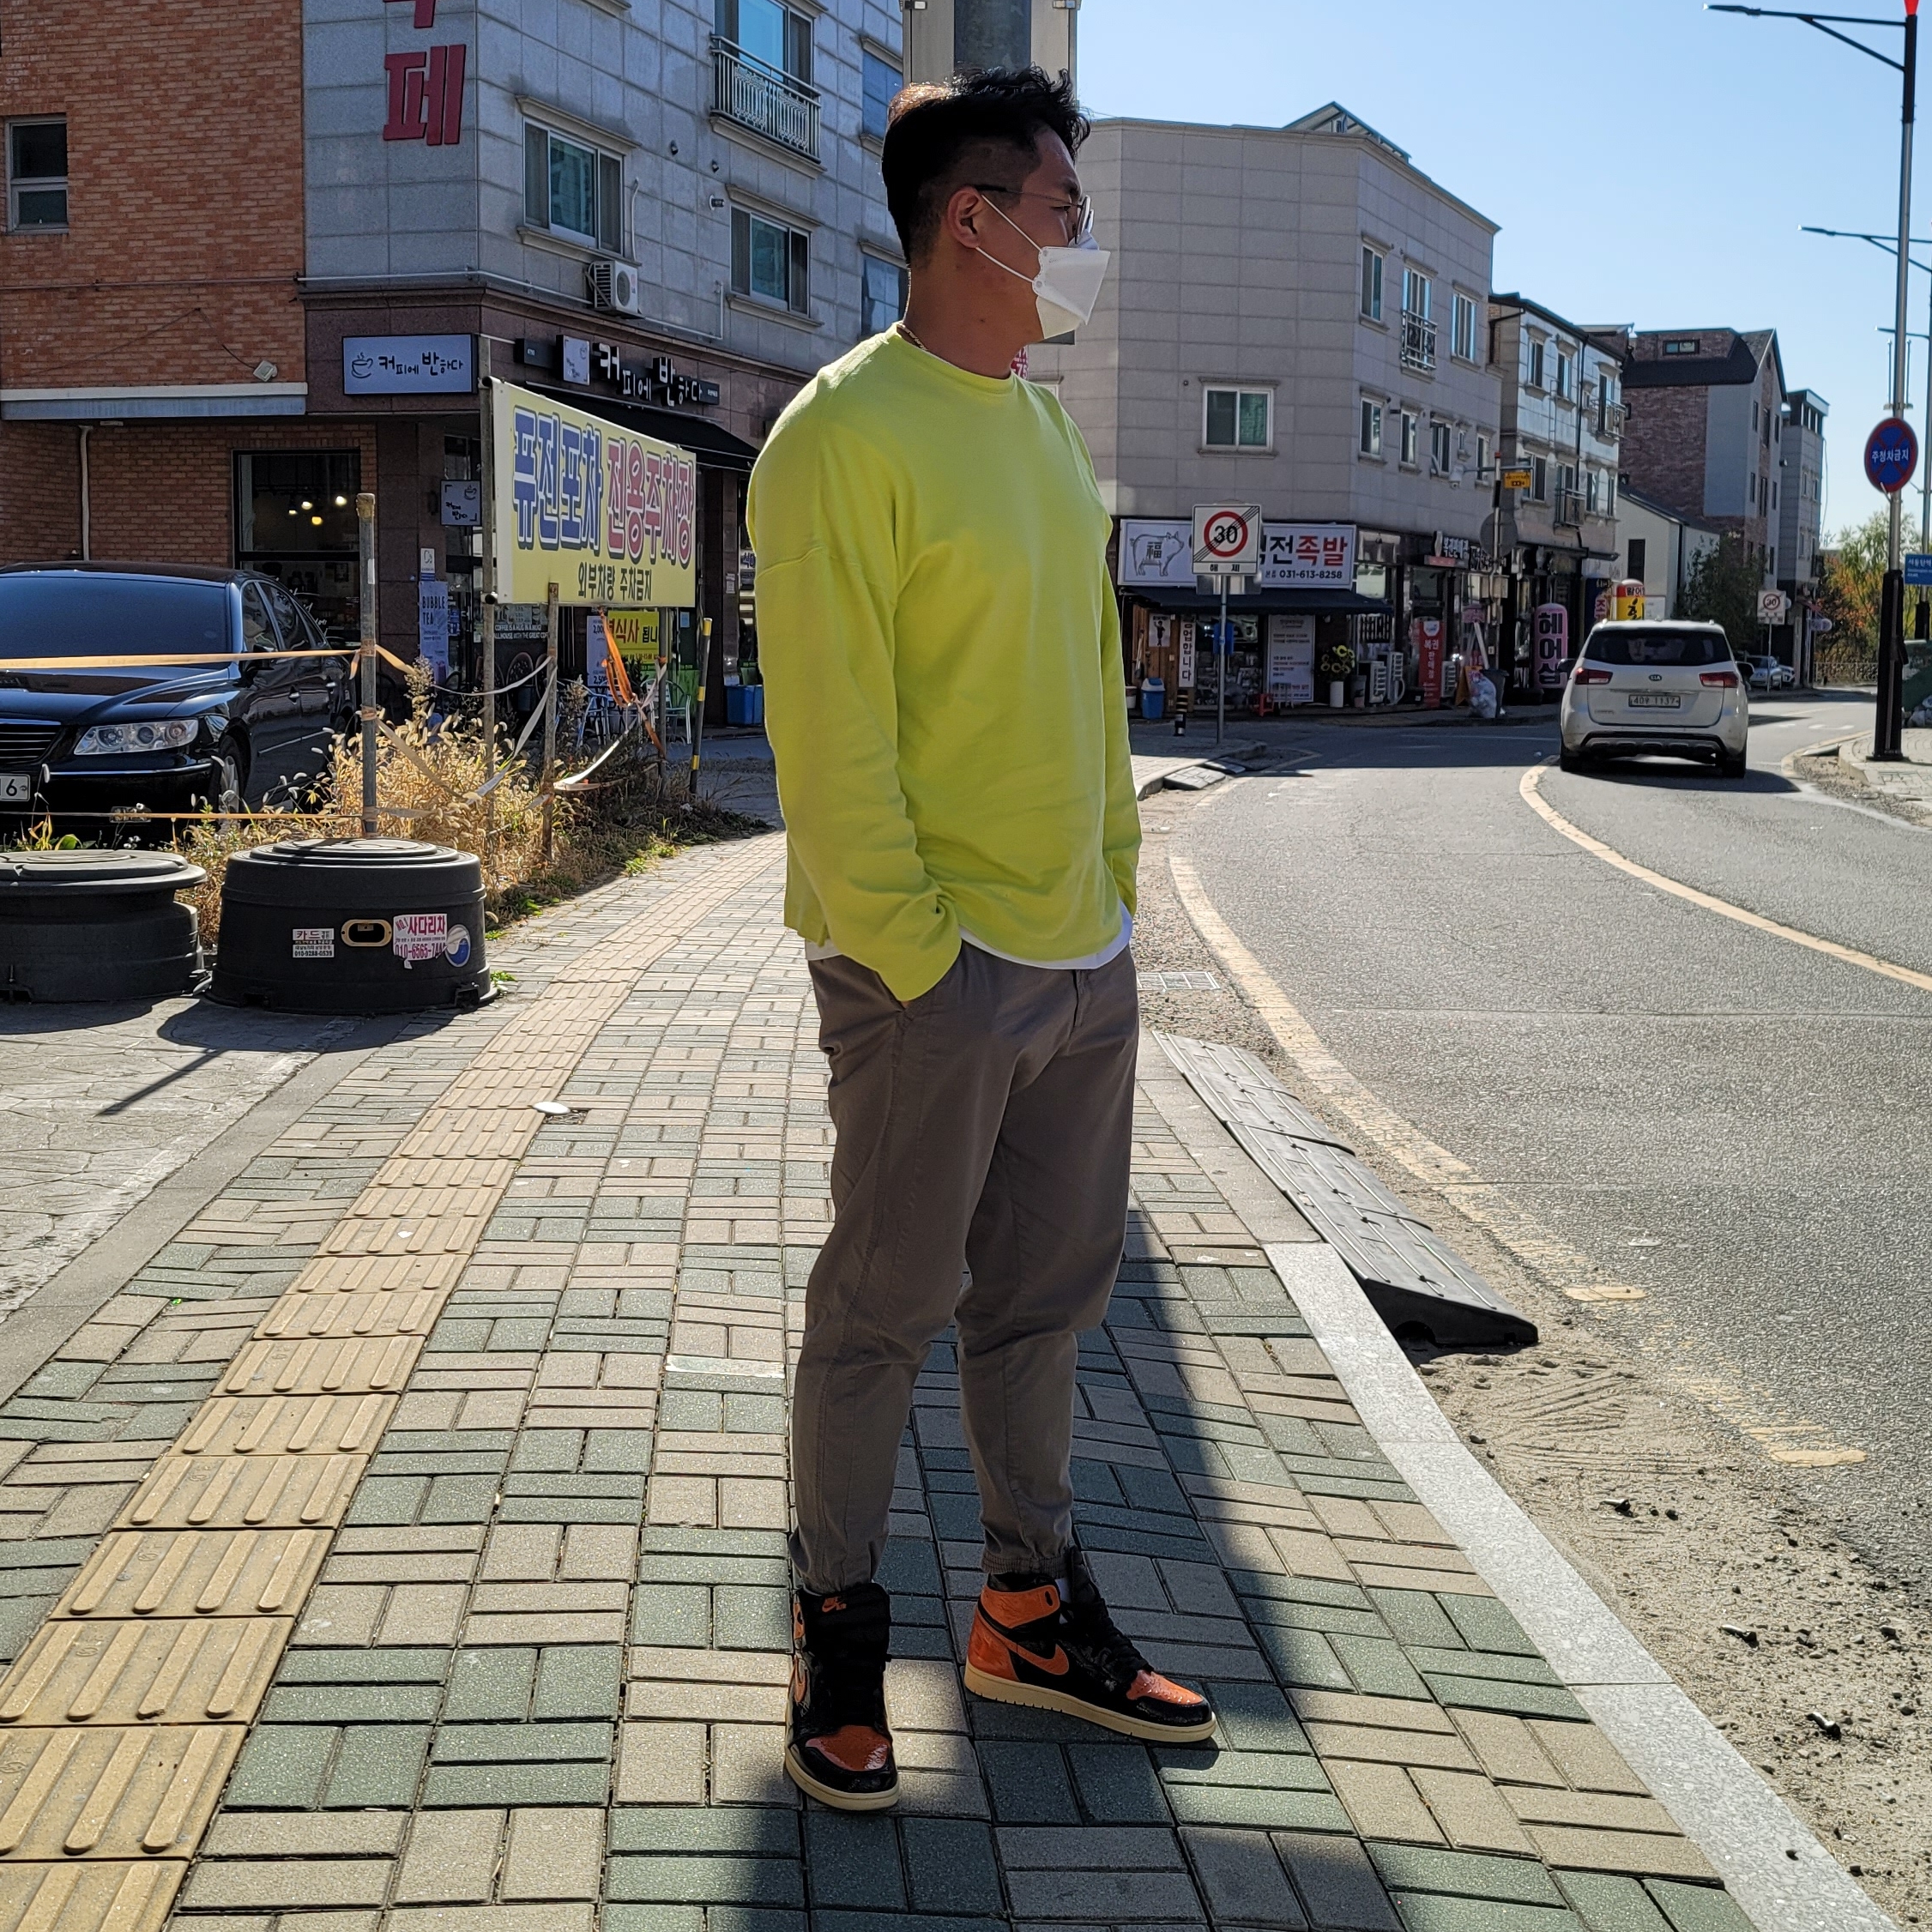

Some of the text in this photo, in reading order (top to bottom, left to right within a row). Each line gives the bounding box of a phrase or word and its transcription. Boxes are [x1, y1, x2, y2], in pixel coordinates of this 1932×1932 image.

[378, 352, 464, 376] 커피에 반하다
[594, 343, 703, 408] 커피에 반하다
[1872, 447, 1910, 464] 주정차금지
[513, 405, 695, 570] 퓨전포차 전용주차장
[1214, 525, 1238, 545] 30
[1146, 541, 1162, 558] 福
[577, 561, 652, 602] 외부차량 주차금지
[1279, 570, 1343, 579] 031-613-8258
[422, 595, 445, 609] BUBBLE
[422, 612, 434, 625] TEA
[408, 915, 446, 936] 사다리차
[296, 930, 321, 940] 카드
